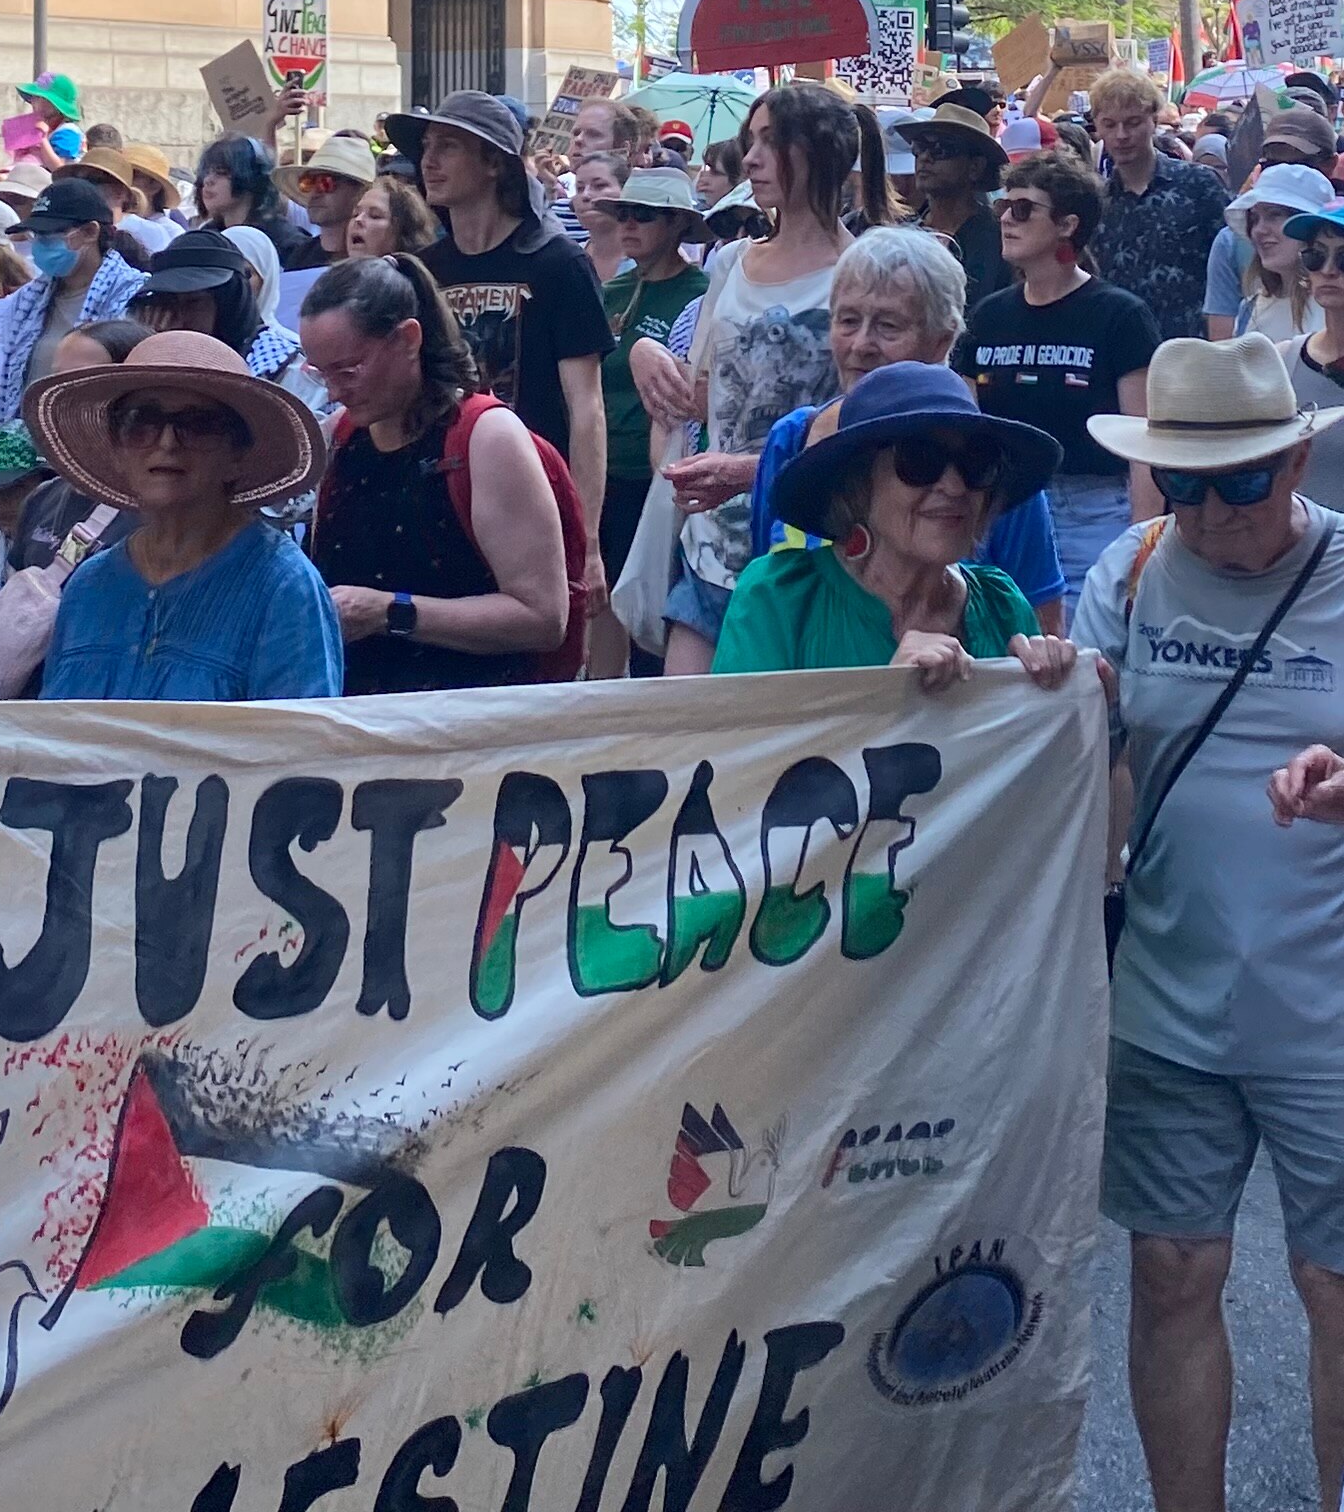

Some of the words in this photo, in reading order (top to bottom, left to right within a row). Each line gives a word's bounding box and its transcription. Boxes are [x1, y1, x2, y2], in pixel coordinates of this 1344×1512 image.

[265, 35, 275, 53] A
[277, 36, 326, 57] CHANCE
[976, 346, 993, 365] NO
[992, 345, 1023, 366] PRIDE
[1024, 345, 1035, 365] IN
[1037, 345, 1095, 368] GENOCIDE
[469, 742, 941, 1020] PEACE
[934, 1238, 1006, 1276] IPAN
